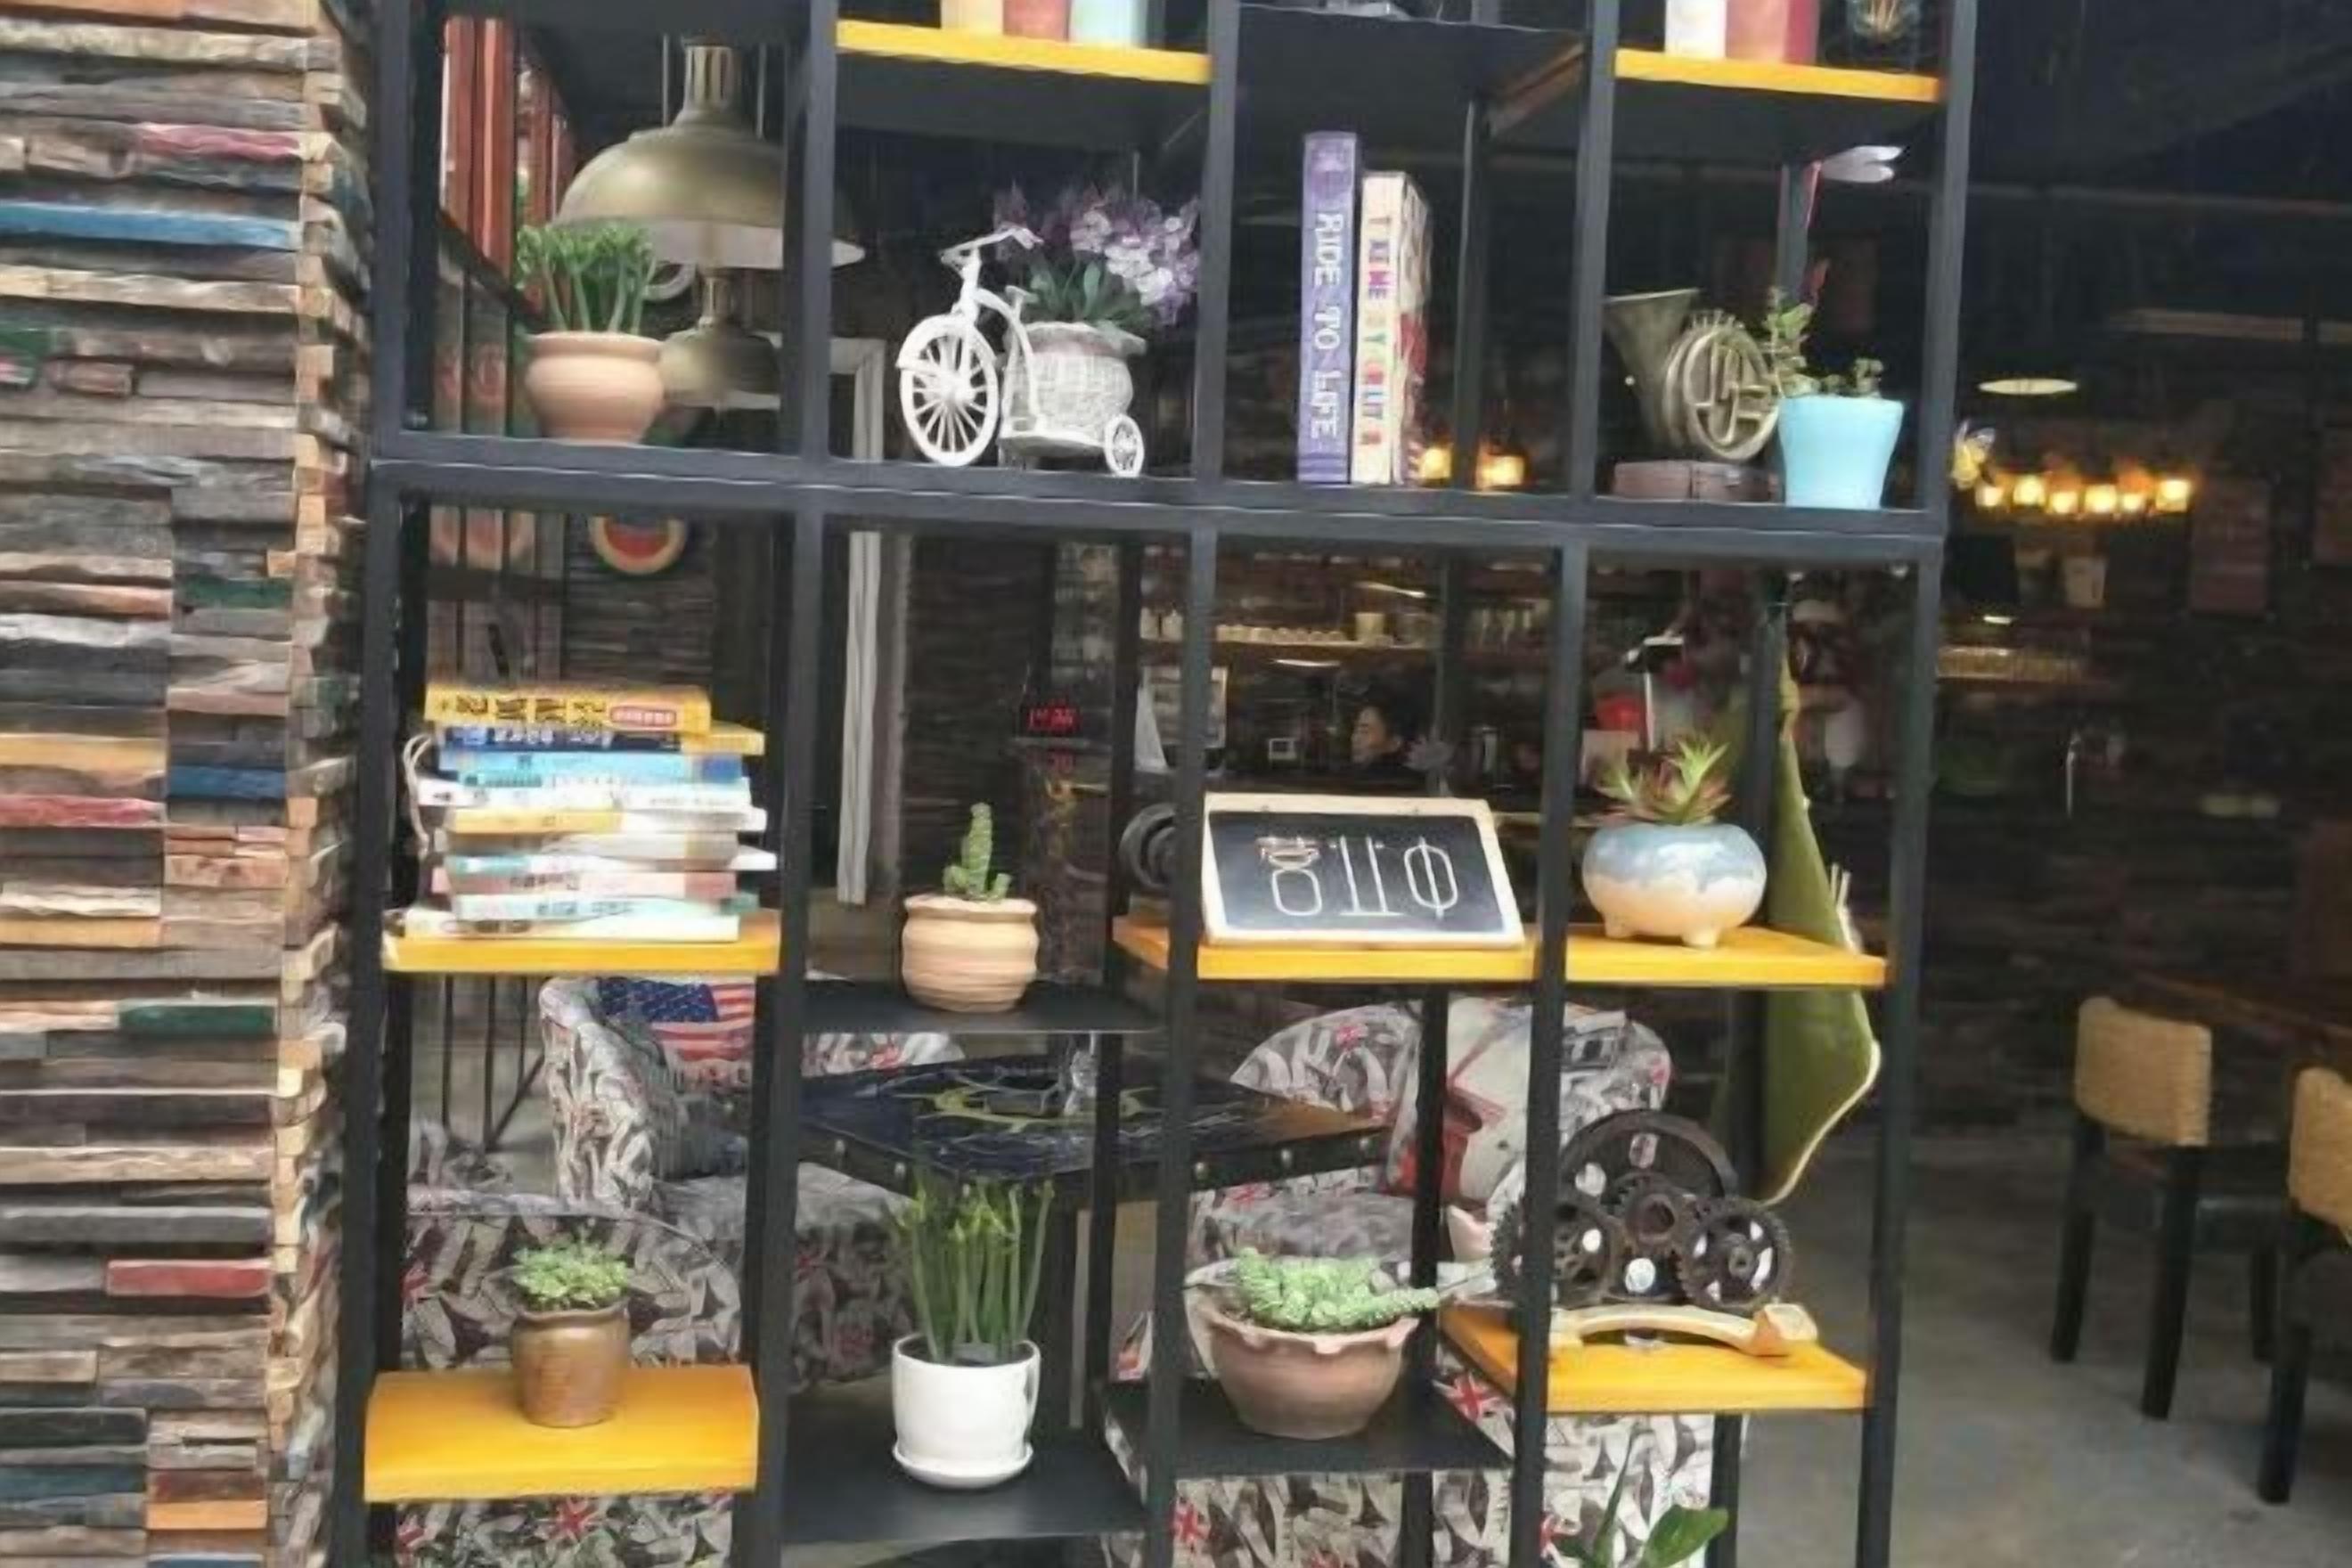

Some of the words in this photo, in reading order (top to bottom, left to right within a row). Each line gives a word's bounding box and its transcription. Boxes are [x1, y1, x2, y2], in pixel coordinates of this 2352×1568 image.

[1314, 212, 1344, 286] RIDE
[1313, 302, 1341, 350] TO
[1311, 370, 1340, 437] LIFE
